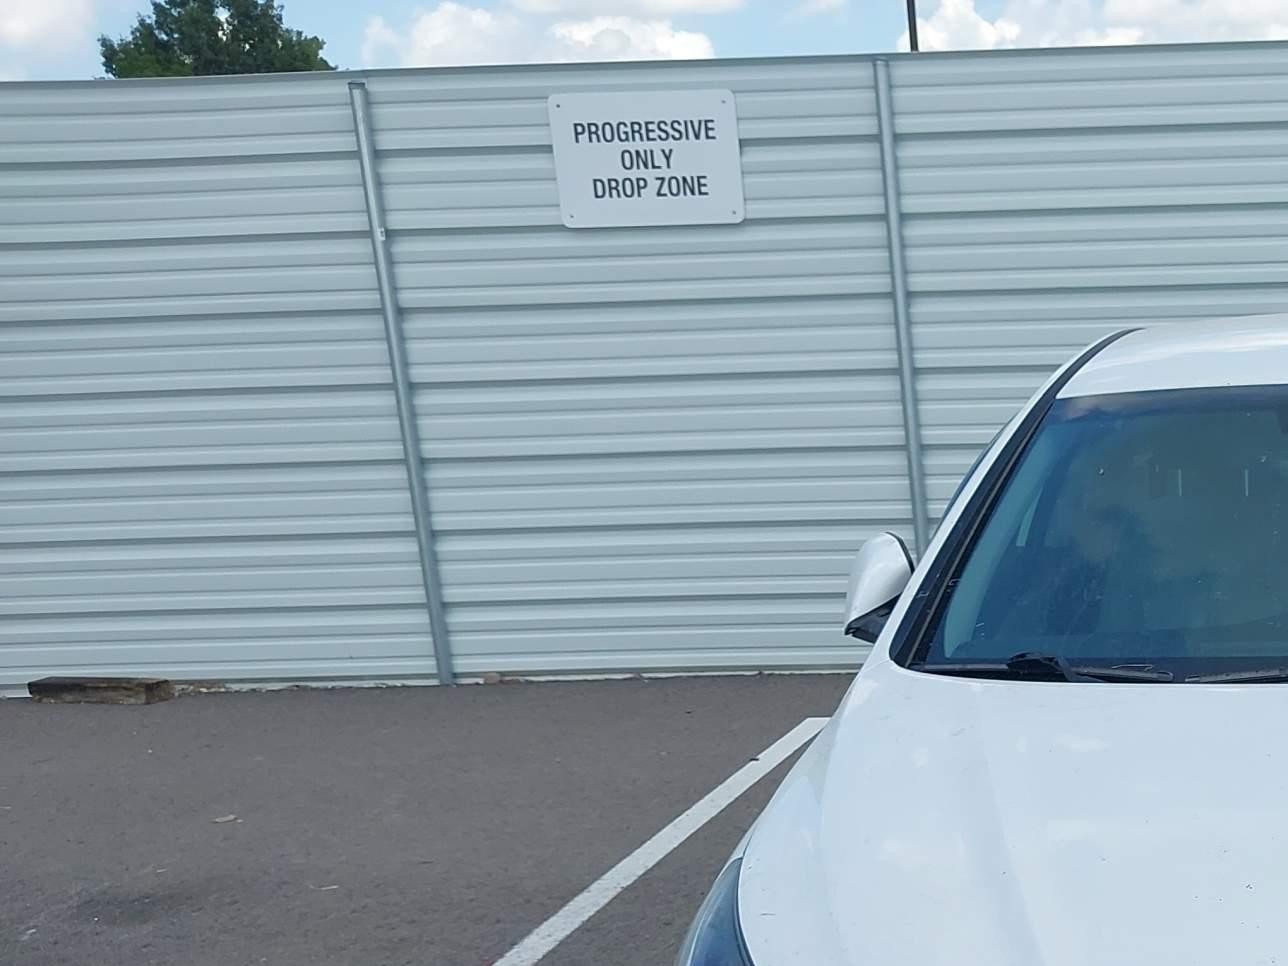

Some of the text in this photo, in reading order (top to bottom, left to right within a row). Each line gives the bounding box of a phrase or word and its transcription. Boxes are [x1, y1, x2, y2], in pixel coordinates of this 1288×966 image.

[573, 119, 717, 144] PROGRESSIVE
[621, 148, 673, 170] ONLY
[592, 175, 709, 199] DROP ZONE
